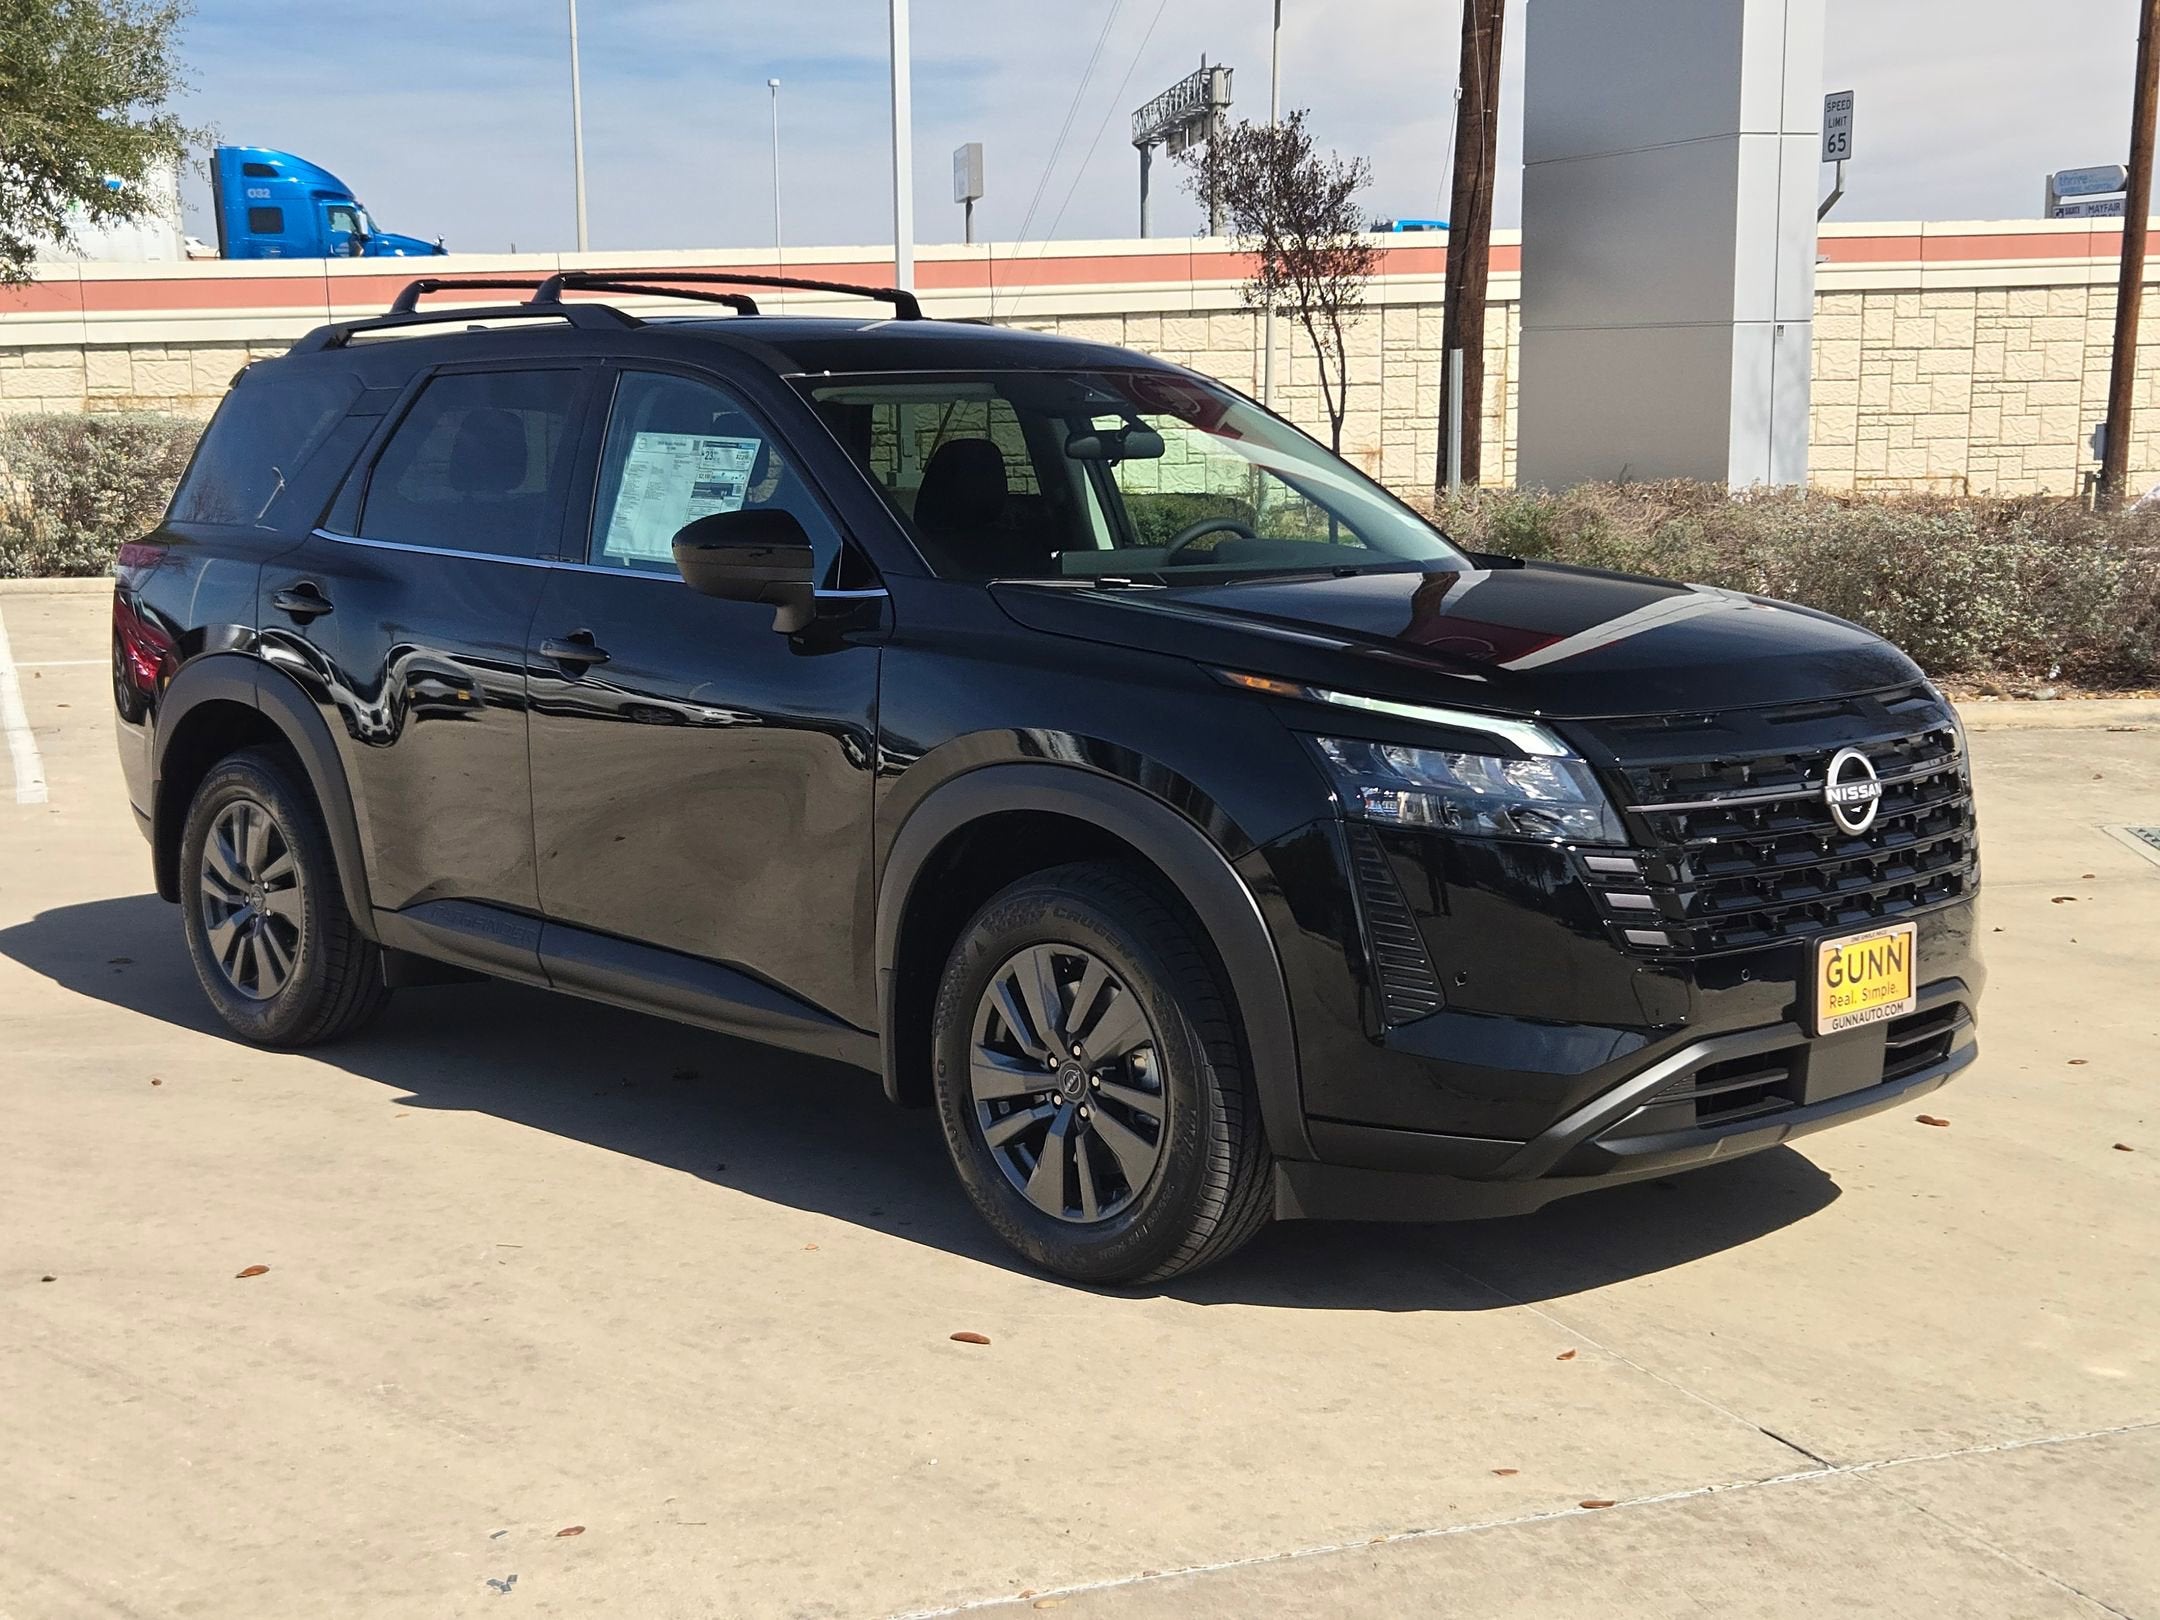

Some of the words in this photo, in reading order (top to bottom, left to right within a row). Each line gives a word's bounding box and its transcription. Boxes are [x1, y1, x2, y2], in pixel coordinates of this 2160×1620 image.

[1826, 99, 1851, 113] SPEED
[1828, 115, 1847, 129] LIMIT
[1827, 132, 1847, 154] 65
[247, 188, 271, 199] 032
[2088, 202, 2120, 214] MAYFAIR
[1826, 781, 1882, 803] NISSAN
[1826, 942, 1903, 989] GUNN
[1829, 990, 1858, 1009] Real.
[1862, 981, 1899, 1002] Simple.
[1832, 1002, 1904, 1030] GUNNAUTO.COM
